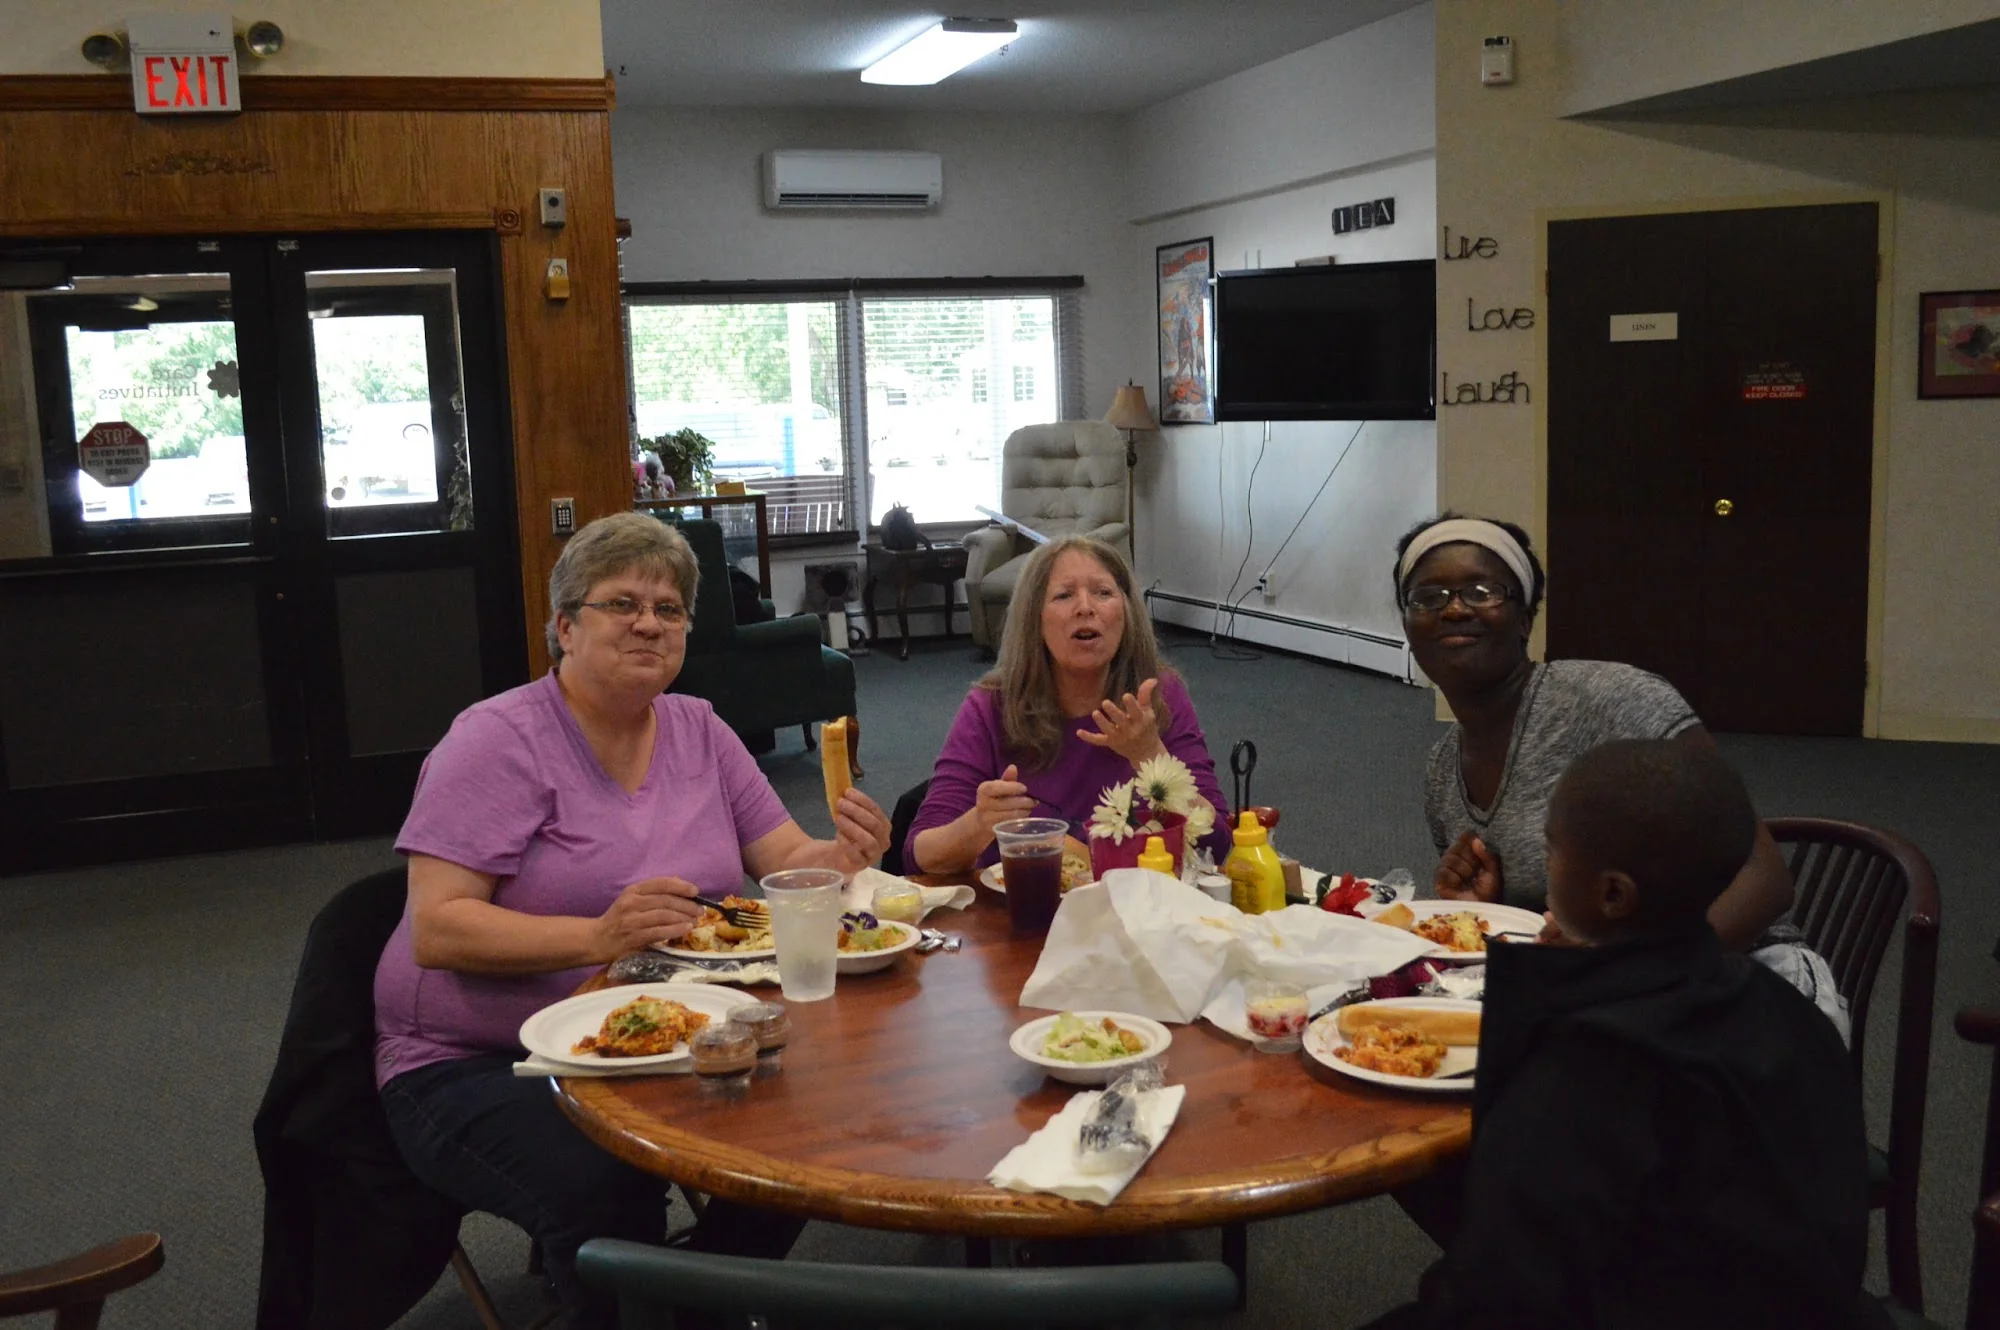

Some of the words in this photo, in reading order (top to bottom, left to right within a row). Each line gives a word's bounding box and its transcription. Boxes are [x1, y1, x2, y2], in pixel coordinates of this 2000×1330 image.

[145, 56, 229, 107] EXIT
[1443, 226, 1498, 261] Live
[1467, 298, 1535, 332] Love
[1442, 371, 1530, 405] Laugh
[93, 428, 133, 445] STOP
